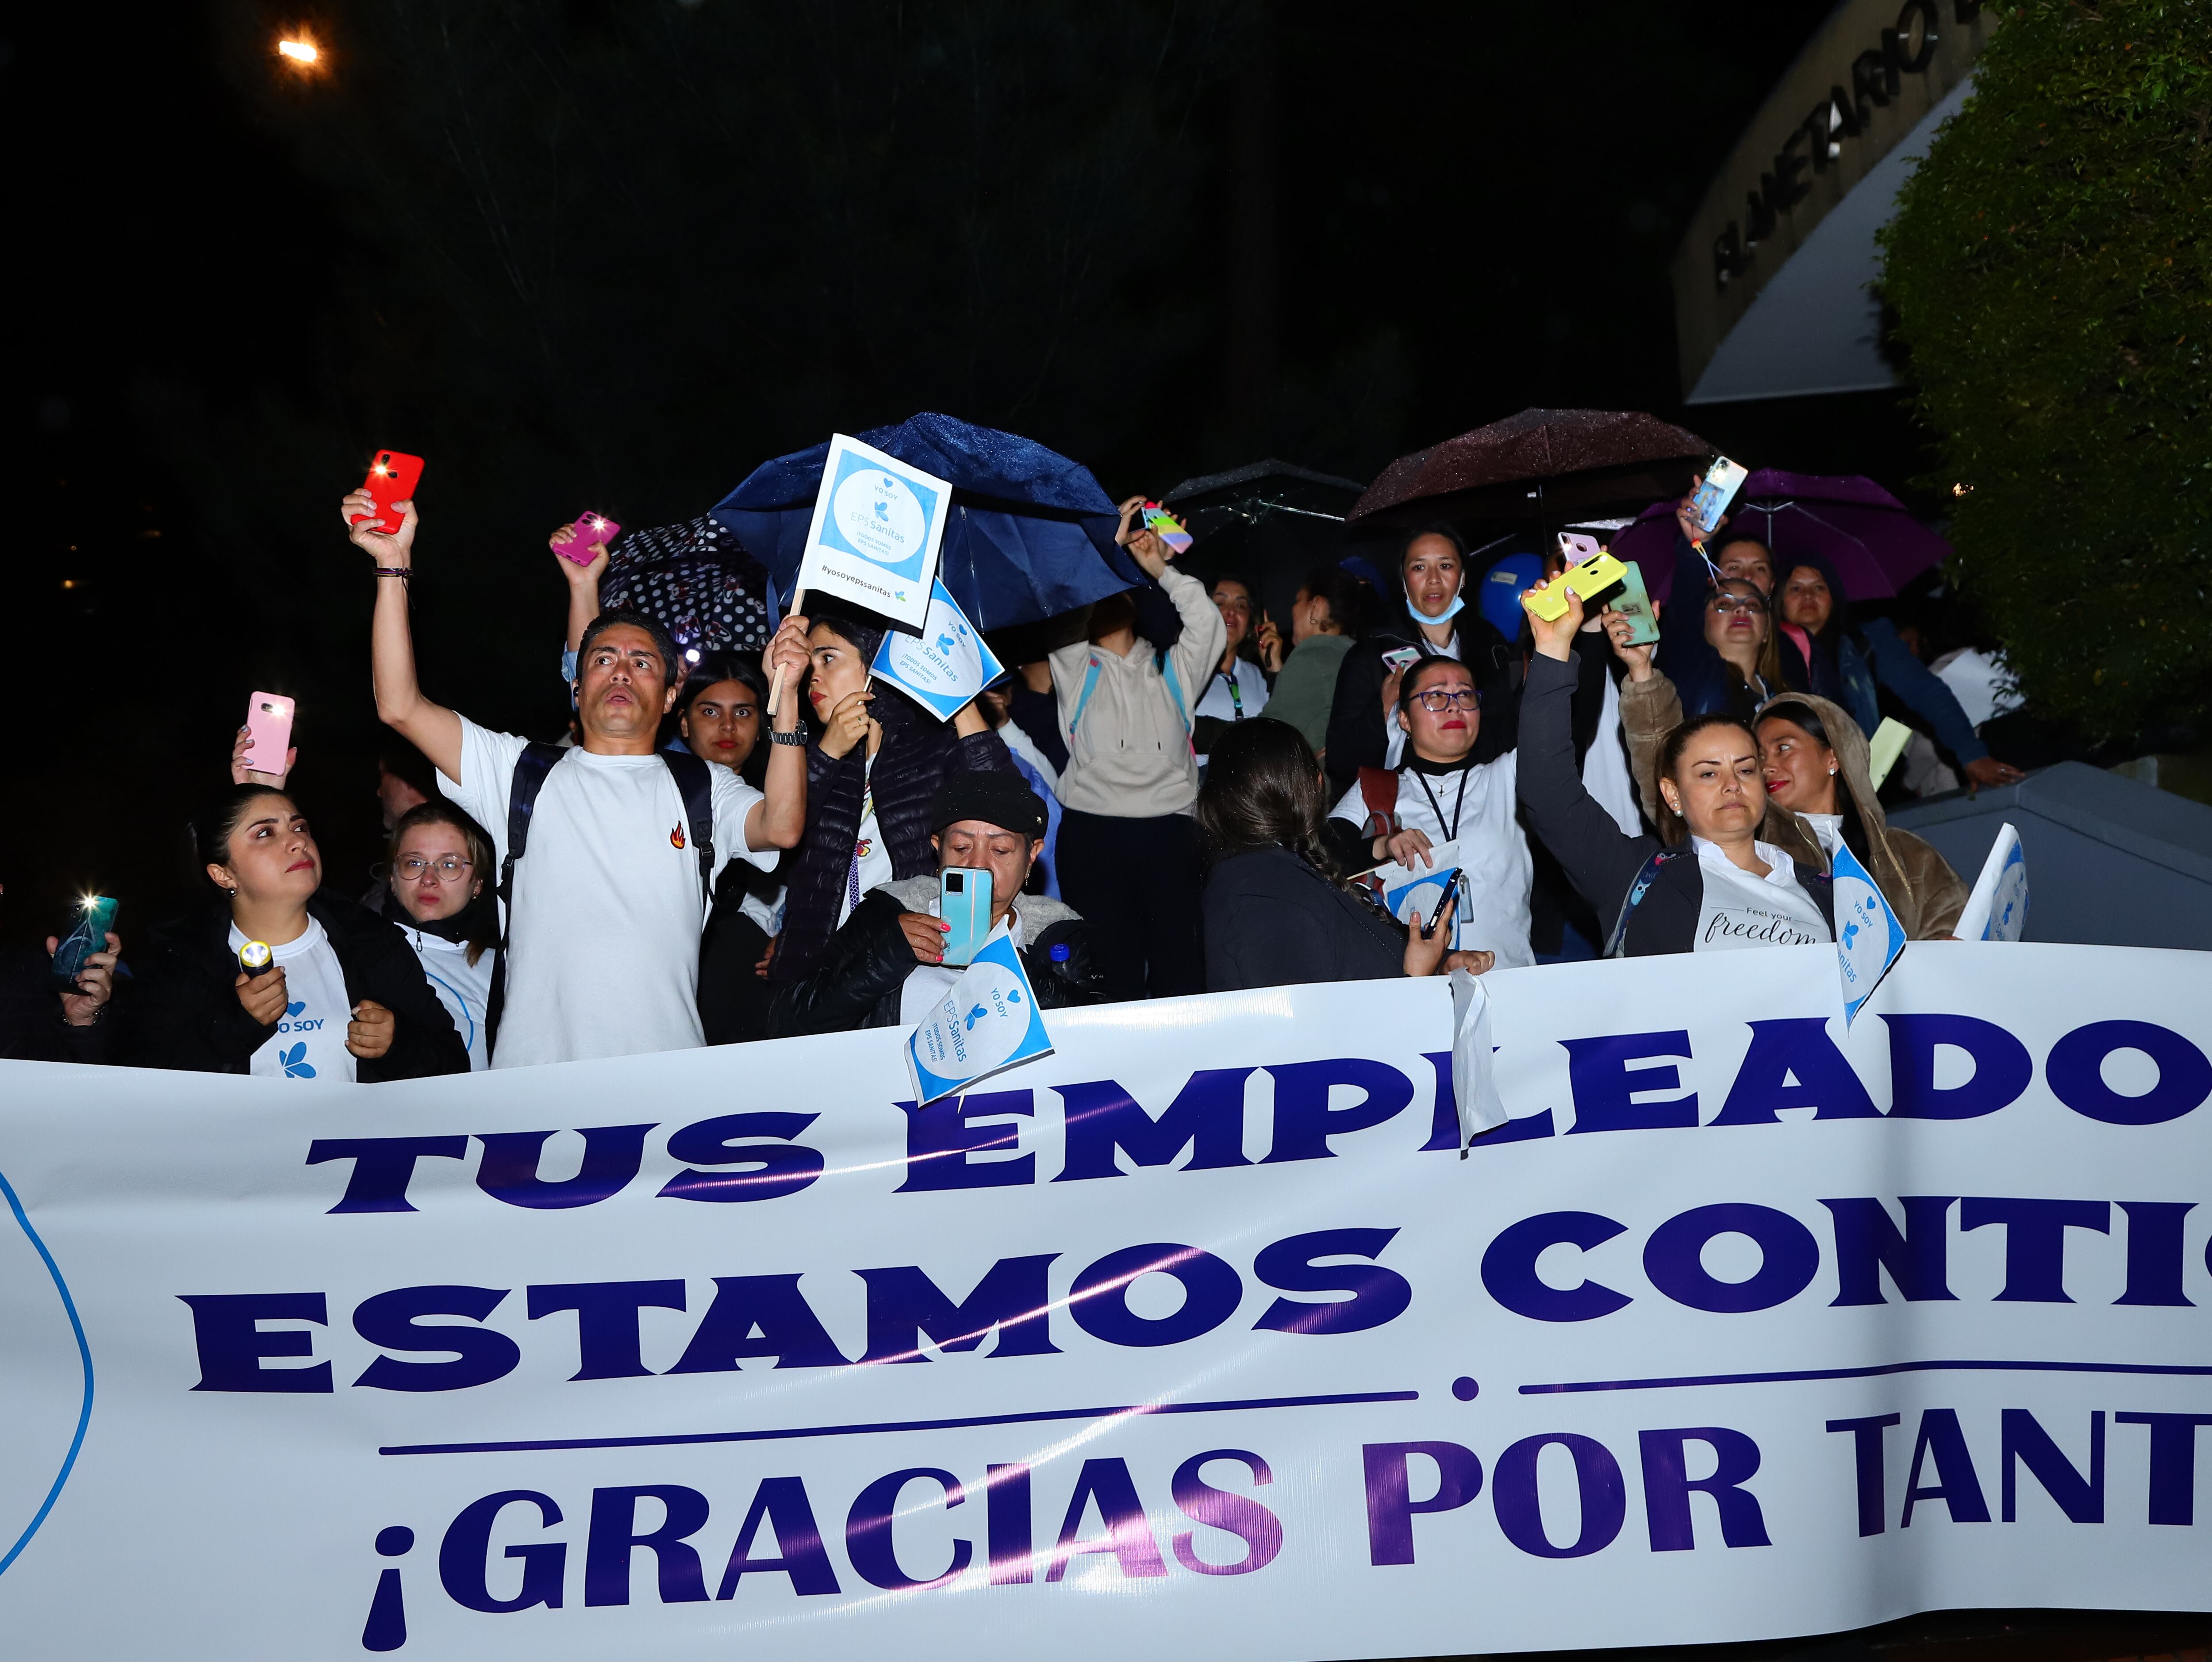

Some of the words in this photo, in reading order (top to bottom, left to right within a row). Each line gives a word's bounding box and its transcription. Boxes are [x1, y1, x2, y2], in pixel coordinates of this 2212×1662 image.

[874, 485, 883, 494] YO
[884, 491, 898, 500] SOY
[856, 531, 874, 542] ¡TODOS
[875, 539, 892, 550] SOMOS
[868, 543, 889, 556] SANITAS!
[822, 564, 891, 597] #yosoyepssanitas
[948, 621, 956, 632] YO
[956, 633, 966, 648] SOY
[899, 660, 910, 668] EPS
[909, 666, 931, 684] SANITAS!
[902, 653, 921, 667] ¡TODOS
[919, 665, 938, 680] SOMOS
[1747, 907, 1768, 917] Feel
[1771, 913, 1793, 921] your
[1854, 900, 1863, 914] YO
[1861, 912, 1873, 928] SOY
[1705, 912, 1816, 945] freedom
[991, 987, 1001, 1001] YO
[995, 1001, 1008, 1017] SOY
[294, 1018, 324, 1032] SOY
[927, 1040, 937, 1062] SANITAS!
[932, 1022, 941, 1042] ¡TODOS
[937, 1041, 945, 1060] SOMOS
[305, 1111, 826, 1214] TUS
[176, 1227, 1412, 1393] ESTAMOS
[1480, 1196, 2212, 1322] CONTI
[362, 1448, 1283, 1652] ¡GRACIAS
[1362, 1427, 1772, 1566] POR
[1826, 1408, 2212, 1538] TANT
